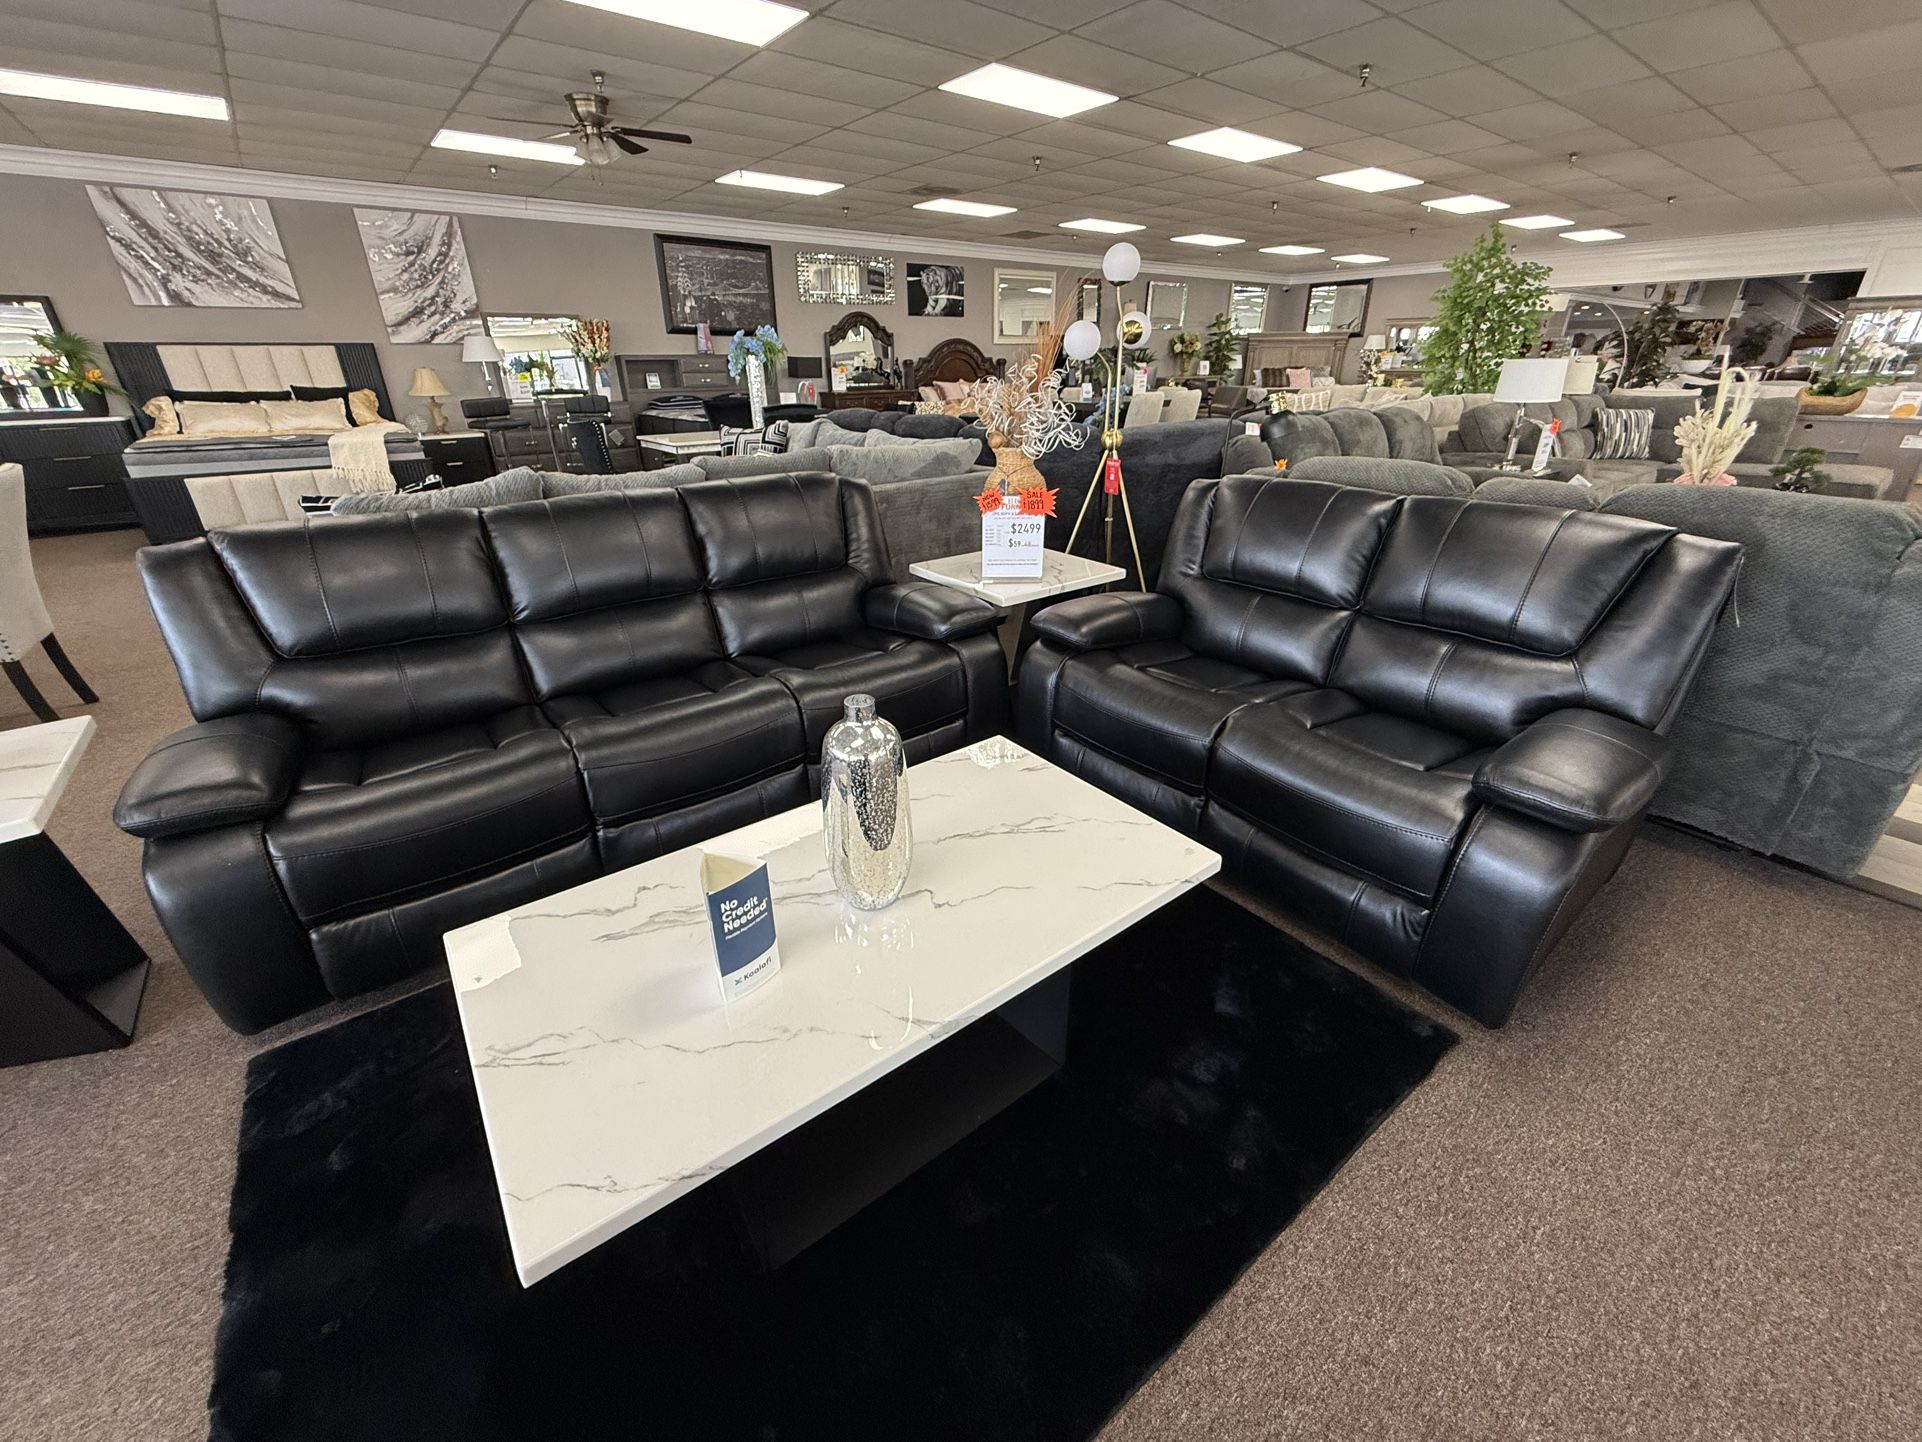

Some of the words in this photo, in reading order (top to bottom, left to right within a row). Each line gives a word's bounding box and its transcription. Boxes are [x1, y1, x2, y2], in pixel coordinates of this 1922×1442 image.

[1026, 491, 1043, 499] SALE
[1011, 523, 1041, 535] $2499
[720, 899, 738, 914] No
[722, 896, 758, 922] Credit
[743, 956, 772, 981] Koalafi
